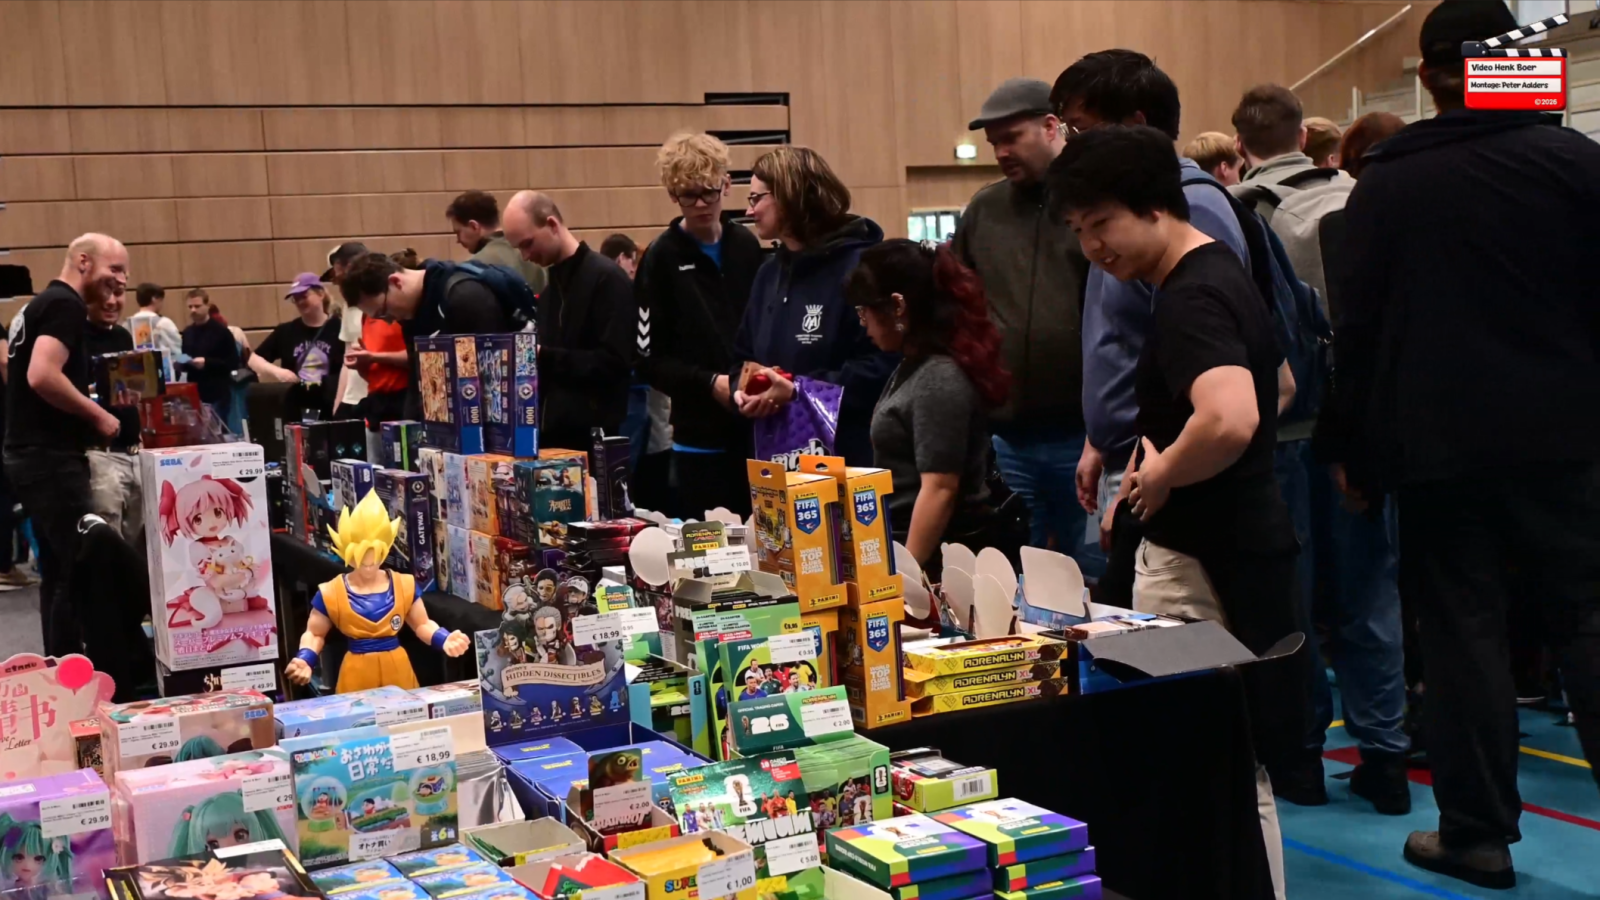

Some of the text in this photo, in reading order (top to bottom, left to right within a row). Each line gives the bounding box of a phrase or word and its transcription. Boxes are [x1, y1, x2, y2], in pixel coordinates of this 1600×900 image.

[470, 406, 480, 424] 1000
[526, 406, 534, 424] 1000
[160, 458, 182, 466] SEGA
[855, 492, 874, 502] FIFA
[796, 501, 816, 511] FIFA
[856, 503, 875, 513] 365
[797, 512, 818, 521] 365
[860, 542, 880, 552] TOP
[800, 552, 822, 562] TOP
[868, 620, 886, 628] FIFA
[599, 630, 620, 639] 18,99
[868, 629, 887, 639] 365
[964, 650, 1040, 668] ADRENALYN XL
[506, 670, 541, 682] HIDDEN
[544, 668, 602, 681] DISSECTIBLES
[870, 669, 890, 678] TOP
[954, 670, 1032, 688] ADRENALYN XL
[962, 687, 1040, 706] ADRENALYN XL
[244, 708, 268, 720] SEGA
[158, 740, 179, 749] 29.99
[341, 742, 391, 764] おさわが
[416, 750, 450, 764] € 18,99
[678, 775, 702, 784] PANINI
[636, 801, 650, 810] 2.00
[740, 806, 752, 814] FIFA
[81, 815, 110, 826] € 29.99
[664, 874, 698, 893] SUPE
[726, 876, 752, 890] € 1,00
